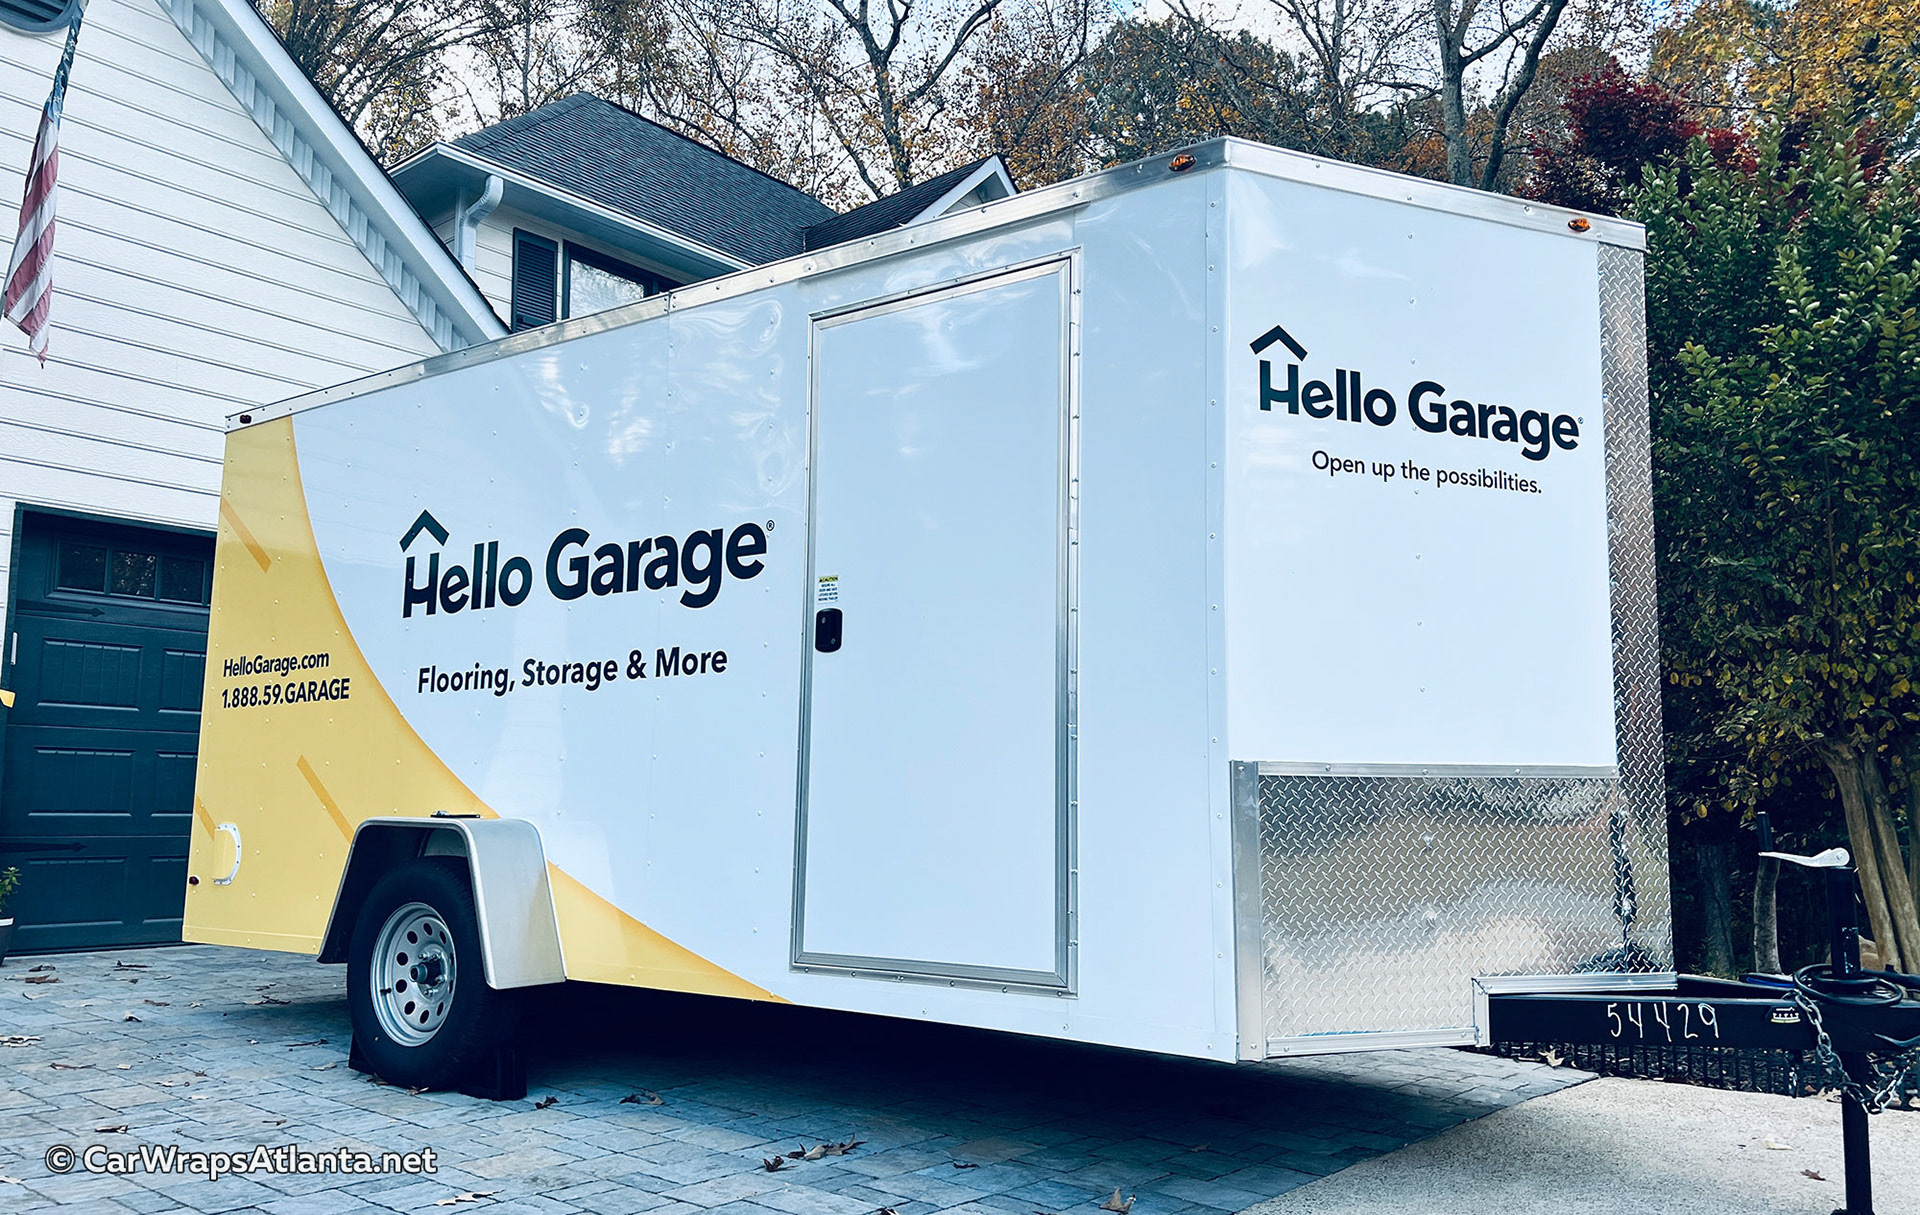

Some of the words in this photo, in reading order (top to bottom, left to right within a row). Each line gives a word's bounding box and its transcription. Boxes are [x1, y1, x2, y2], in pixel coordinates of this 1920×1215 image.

[1259, 359, 1397, 426] Hello
[1312, 450, 1365, 476] Open
[1372, 461, 1395, 482] up
[1401, 460, 1431, 481] the
[1436, 470, 1542, 495] possibilities.
[402, 540, 533, 618] Hello
[223, 652, 330, 678] HelloGarage.com
[418, 662, 516, 697] Flooring,
[522, 658, 618, 692] Storage
[626, 649, 647, 680] &
[655, 646, 728, 678] More
[221, 678, 350, 709] 1.888.59.GARAGE
[1607, 1001, 1719, 1042] 54429
